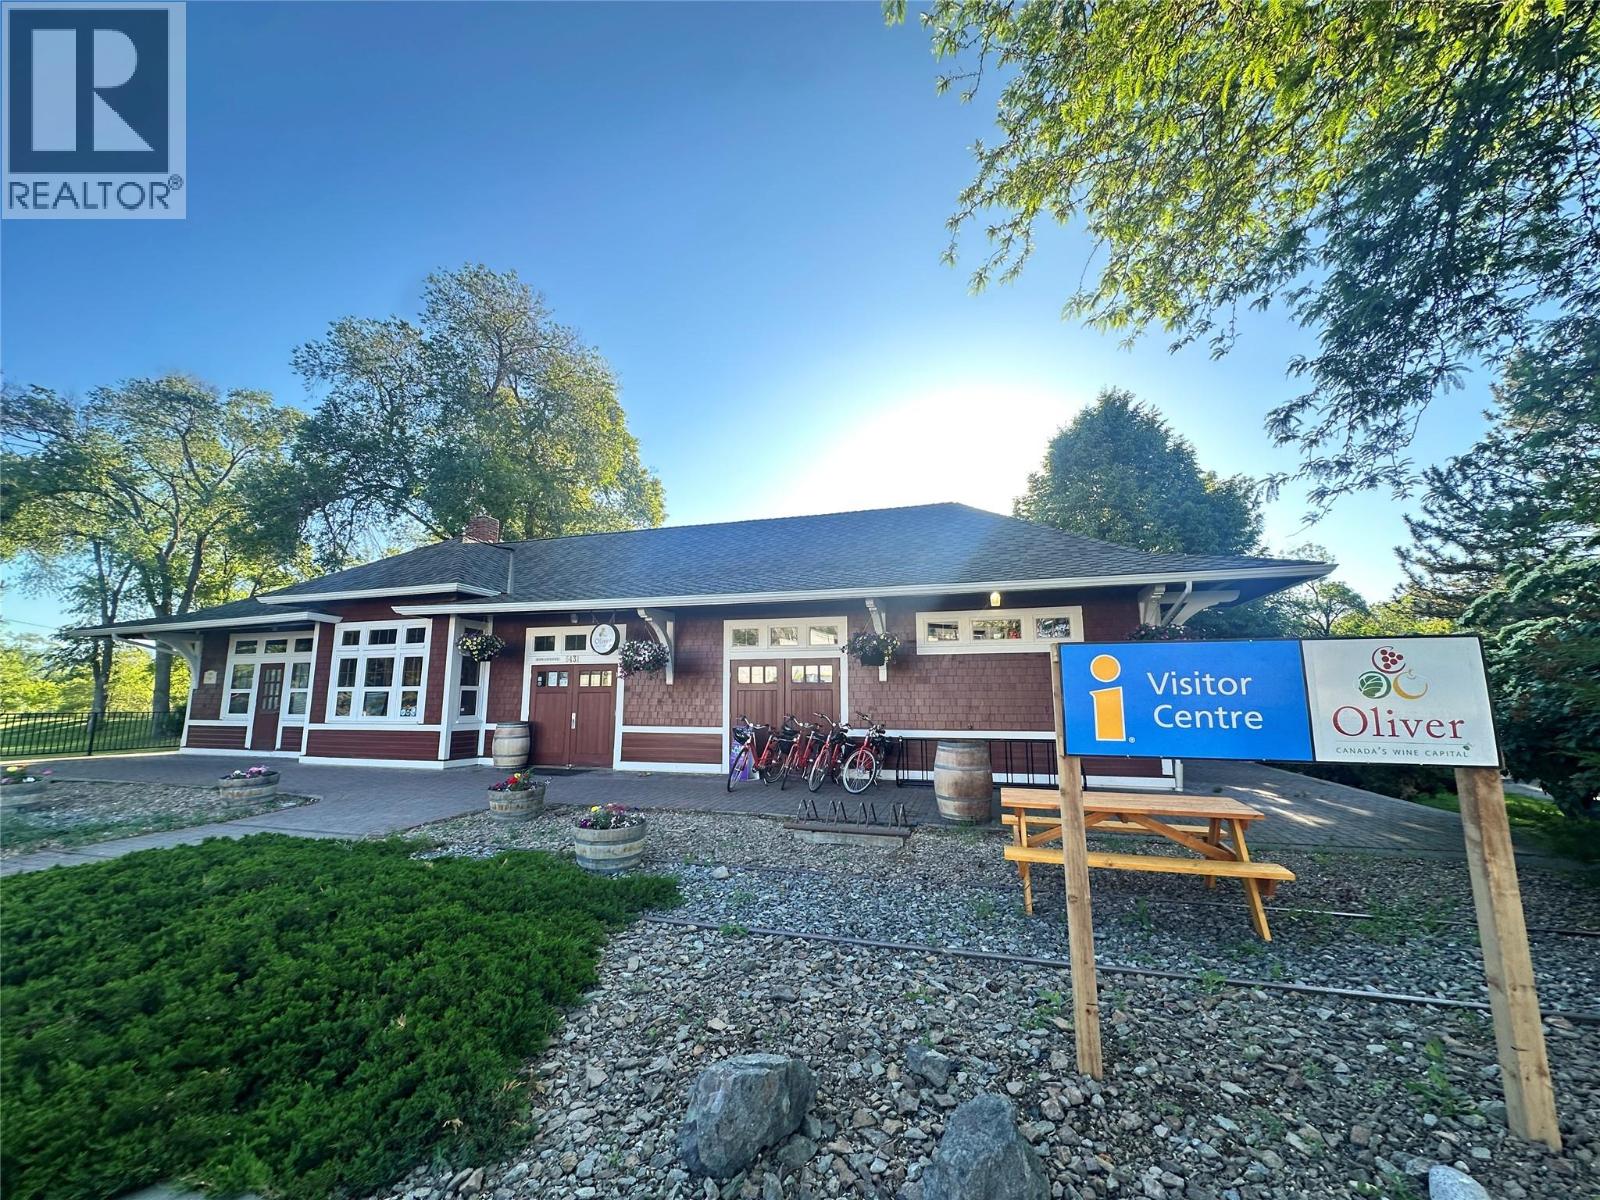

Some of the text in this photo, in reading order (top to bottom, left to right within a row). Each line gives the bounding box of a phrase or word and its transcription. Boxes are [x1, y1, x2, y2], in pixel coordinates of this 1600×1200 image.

[1146, 671, 1252, 696] Visitor
[1153, 704, 1264, 730] Centre
[1332, 706, 1465, 739] Oliver
[1336, 746, 1469, 758] CANADA'S WINE CAPITAL
